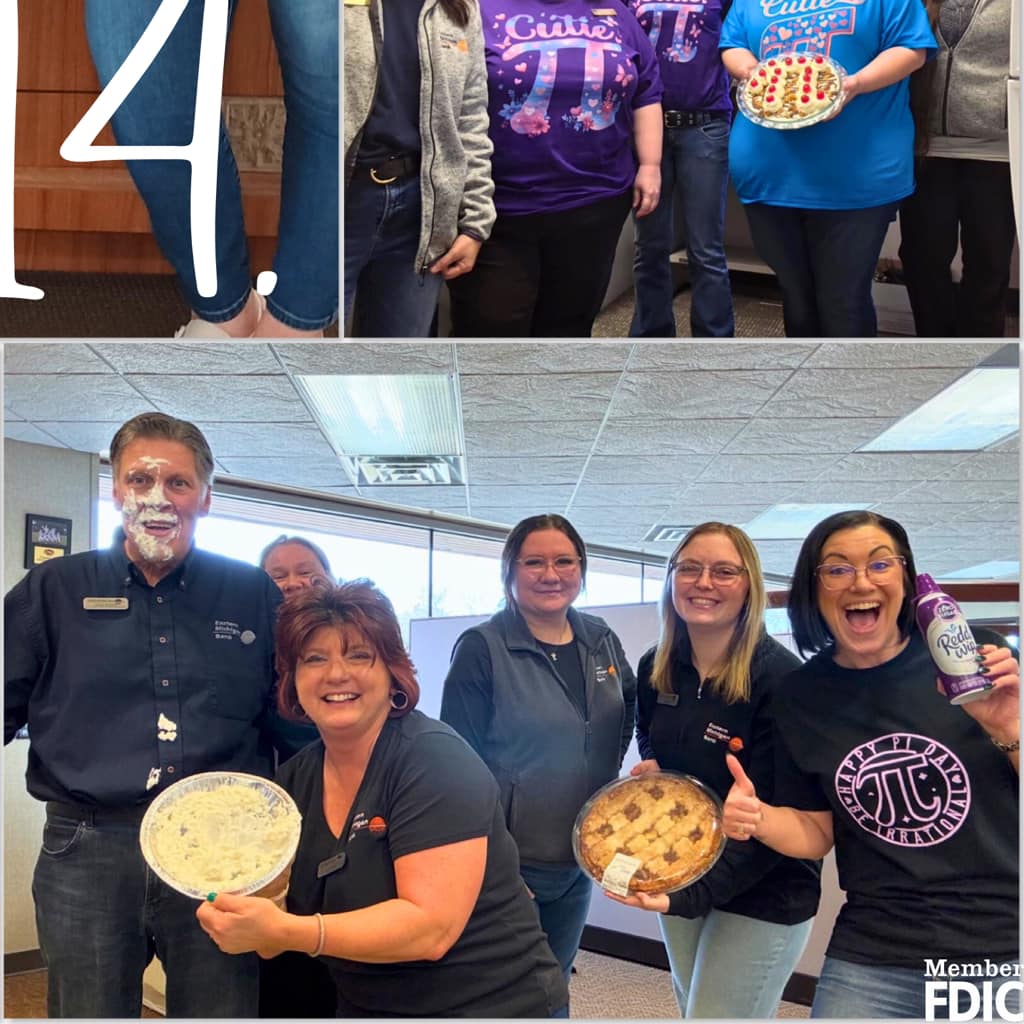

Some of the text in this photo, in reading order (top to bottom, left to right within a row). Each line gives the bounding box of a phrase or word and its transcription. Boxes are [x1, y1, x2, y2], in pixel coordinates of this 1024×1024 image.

[505, 13, 615, 41] Cutie
[838, 736, 961, 794] HAPPY PI DAY
[848, 787, 968, 844] BE IRRATIONAL
